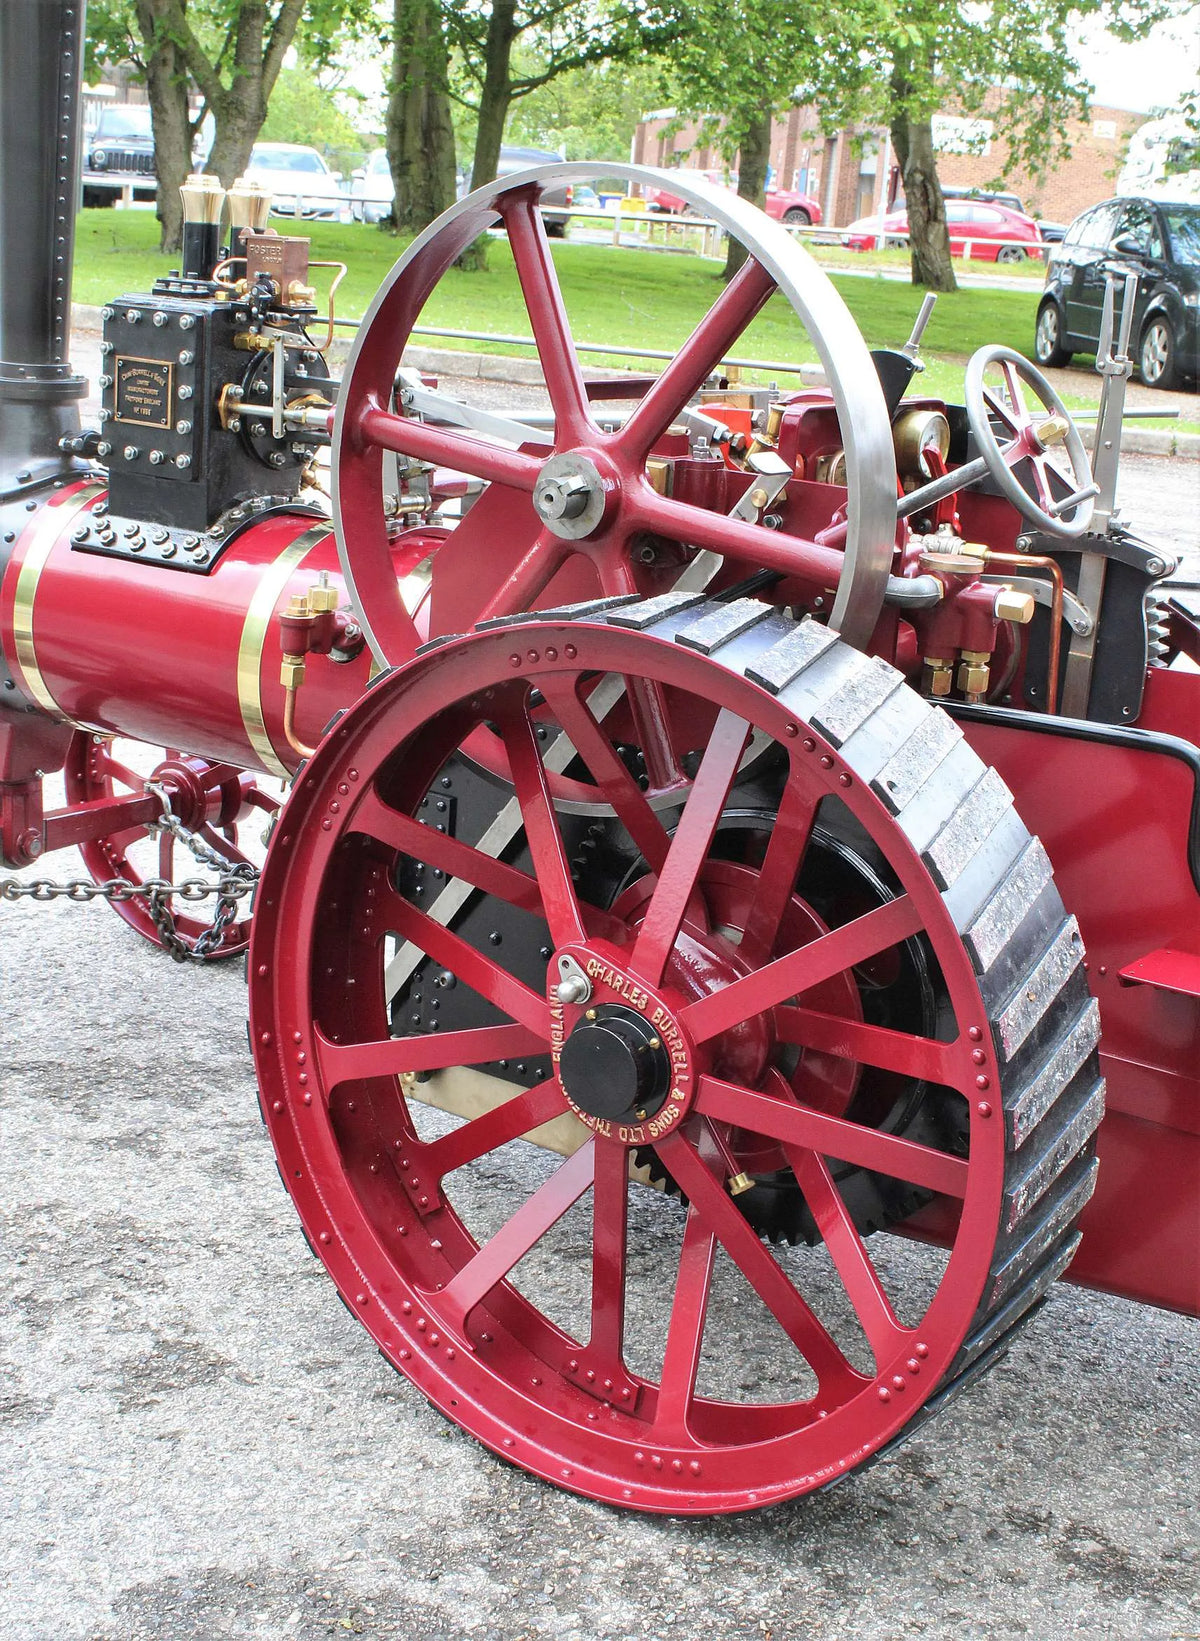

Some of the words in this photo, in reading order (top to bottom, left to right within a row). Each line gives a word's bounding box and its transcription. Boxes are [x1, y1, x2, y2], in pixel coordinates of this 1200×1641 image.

[249, 244, 281, 255] FOSTER
[586, 958, 649, 1010] CHARLES
[651, 1007, 690, 1084] BURRELL
[671, 1087, 686, 1101] &
[648, 1103, 680, 1137] SONS
[619, 1127, 645, 1143] LTD
